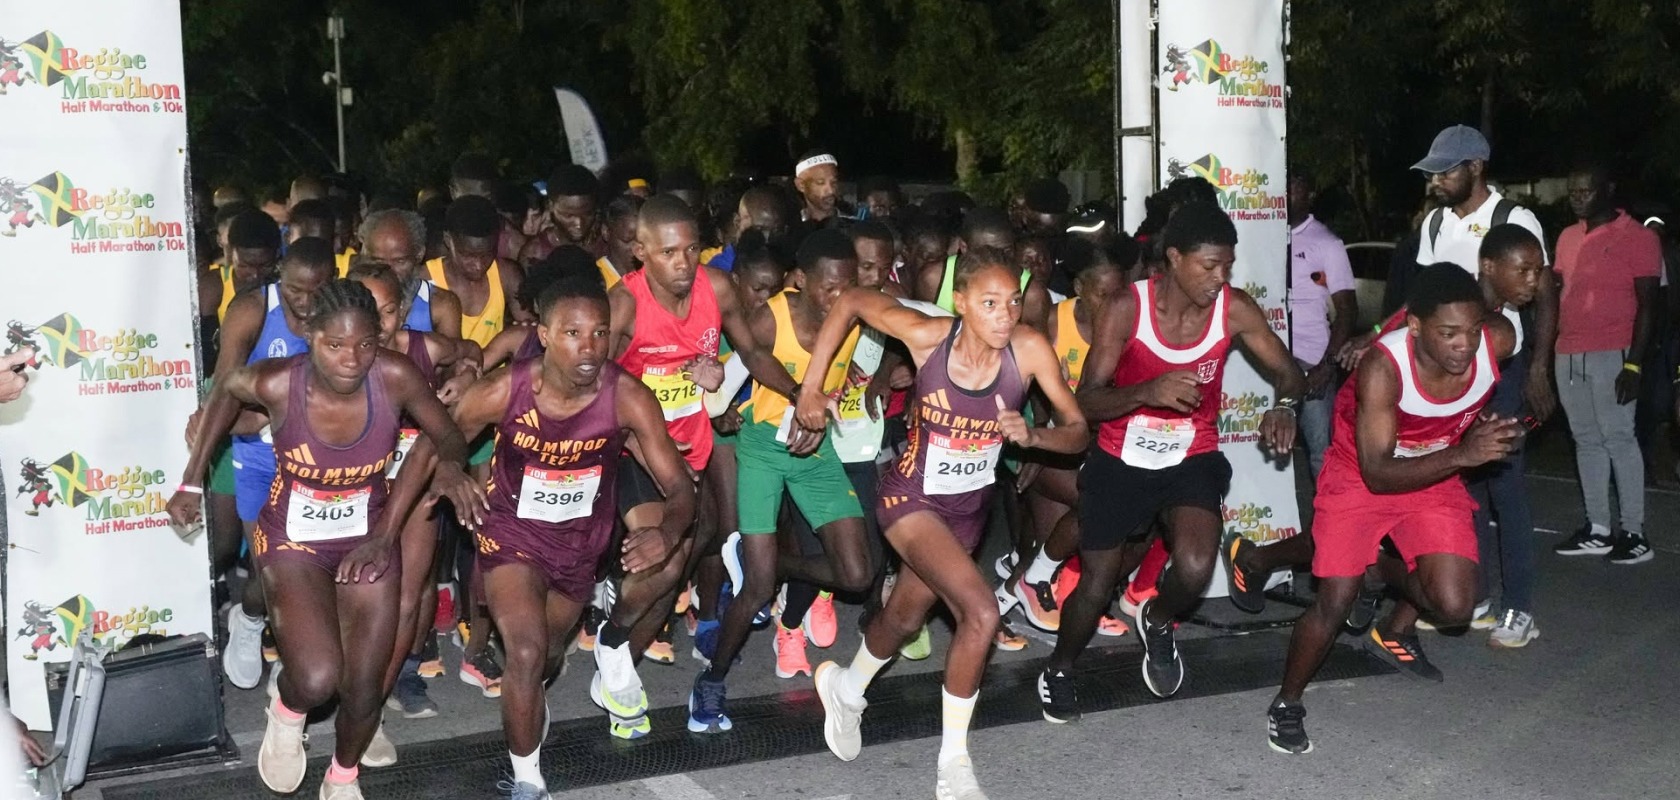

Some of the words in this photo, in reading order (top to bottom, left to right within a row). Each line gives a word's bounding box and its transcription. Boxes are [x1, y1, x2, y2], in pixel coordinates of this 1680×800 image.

[57, 47, 146, 80] Reggae
[1218, 53, 1268, 81] Reggae
[61, 76, 181, 100] Marathon
[1218, 76, 1282, 97] Marathon
[61, 101, 86, 114] Half
[89, 100, 150, 113] Marathon
[153, 102, 161, 112] &
[163, 101, 183, 113] 10k
[1217, 97, 1235, 107] Half
[1236, 97, 1267, 108] Marathon
[1217, 167, 1269, 195] Reggae
[69, 187, 154, 220] Reggae
[1219, 190, 1285, 210] Marathon
[1237, 211, 1270, 221] Marathon
[71, 215, 183, 240] Marathon
[71, 242, 96, 254] Half
[99, 240, 156, 253] Marathon
[157, 241, 164, 251] &
[166, 241, 185, 251] 10k
[75, 327, 158, 361] Reggae
[79, 355, 191, 382] Marathon
[647, 367, 666, 376] HALF
[78, 382, 104, 395] Half
[107, 380, 162, 394] Marathon
[164, 380, 171, 389] &
[173, 377, 194, 389] 10k
[1220, 391, 1269, 418] Reggae
[513, 431, 607, 455] HOLMWOOD
[933, 436, 951, 448] 10K
[950, 428, 991, 440] TECH
[1218, 434, 1230, 444] alf
[1231, 432, 1261, 443] Marath
[1135, 436, 1179, 453] 2226
[540, 452, 581, 466] TECH
[938, 460, 988, 475] 2400
[82, 465, 165, 499] Reggae
[321, 476, 367, 486] TECH
[530, 469, 547, 479] 10K
[297, 485, 315, 498] 10K
[533, 491, 584, 505] 2396
[84, 491, 168, 520] Marath
[302, 505, 354, 521] 2403
[85, 521, 110, 535] Half
[113, 516, 169, 532] Marathon
[90, 605, 173, 639] Reggae
